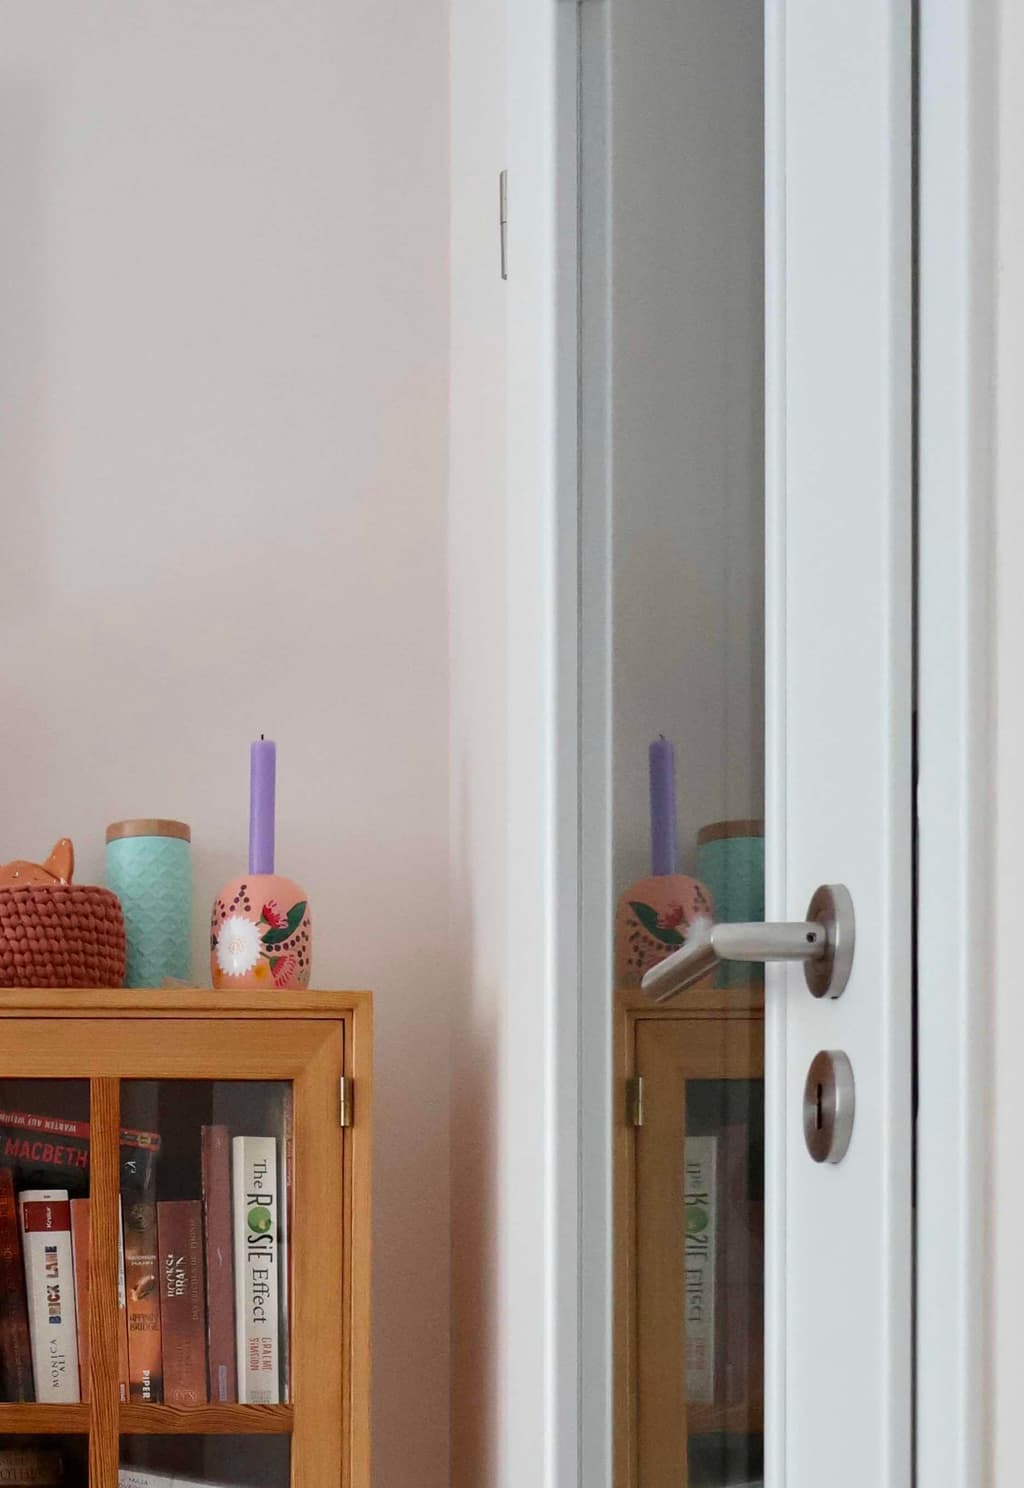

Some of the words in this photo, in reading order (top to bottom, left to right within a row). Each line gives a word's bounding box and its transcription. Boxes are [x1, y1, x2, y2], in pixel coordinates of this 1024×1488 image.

[4, 1136, 88, 1168] MACBETH
[251, 1160, 267, 1189] The
[44, 1245, 57, 1278] LANE
[45, 1285, 61, 1325] BRICK
[252, 1268, 271, 1324] Effect
[49, 1338, 61, 1388] MONICA
[57, 1354, 66, 1372] ALI
[142, 1369, 151, 1399] PIPER
